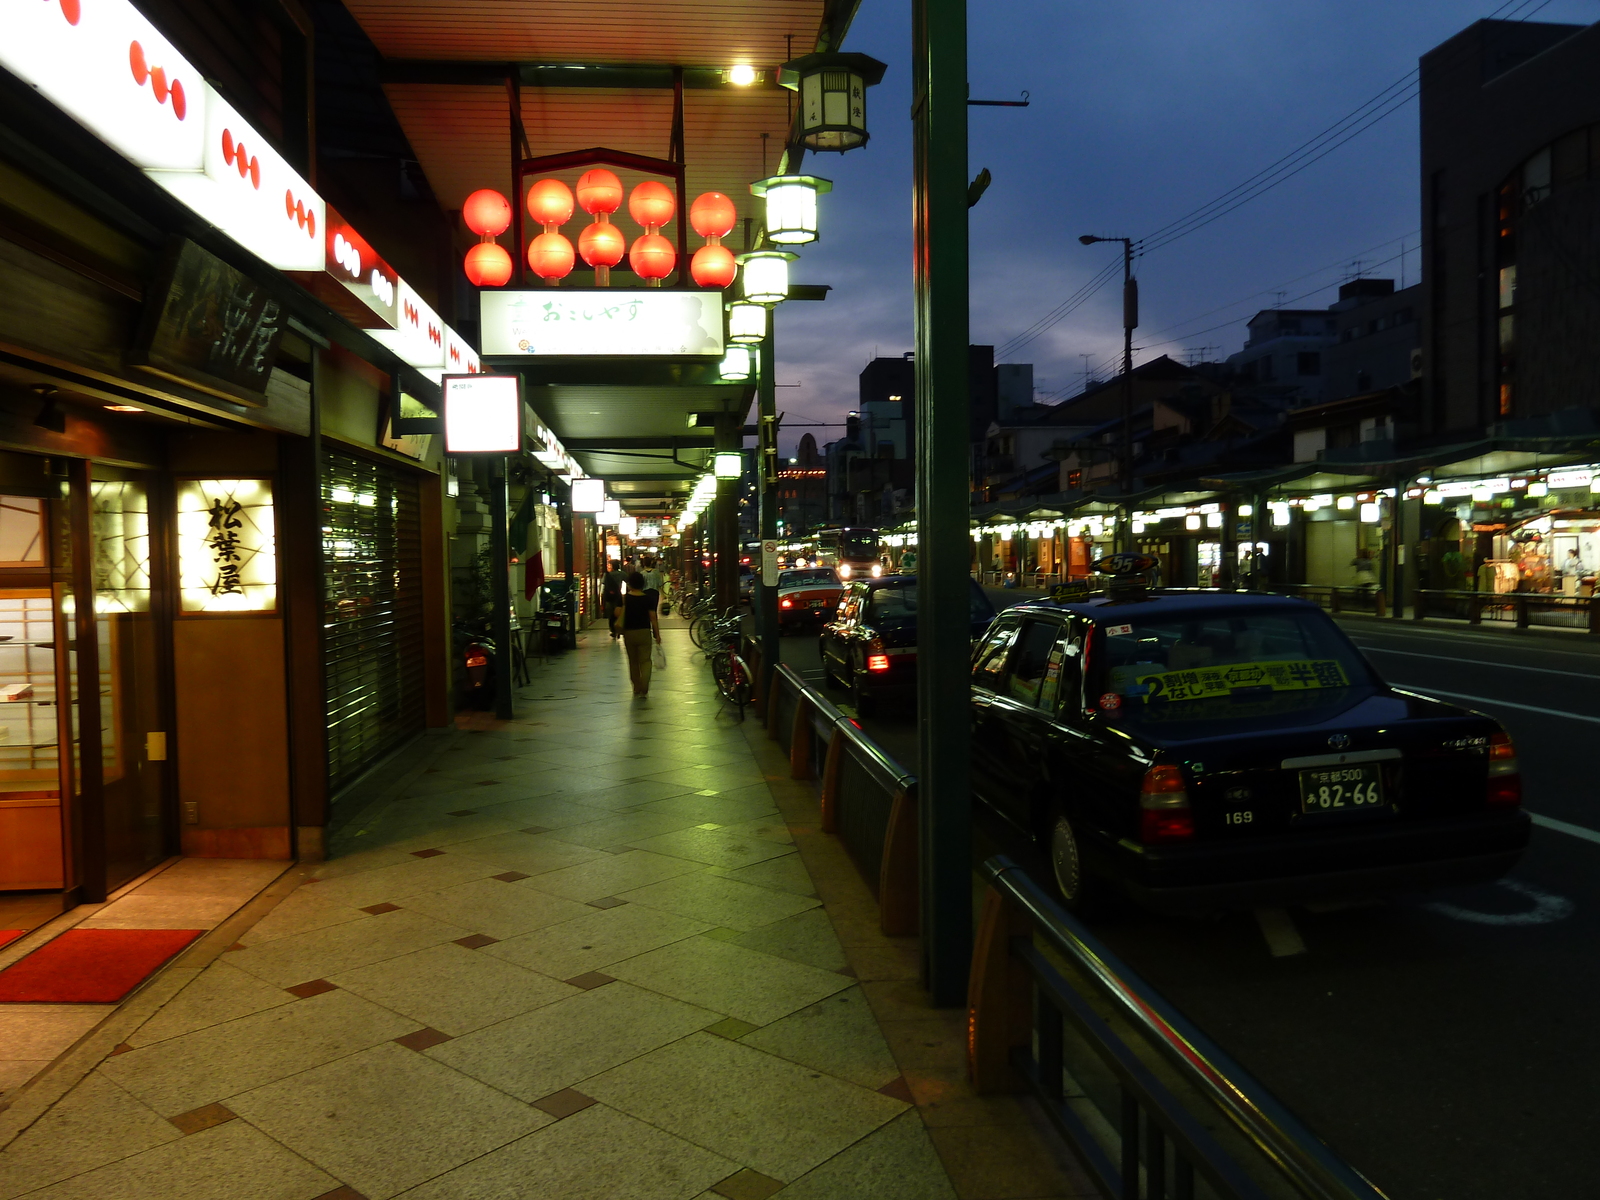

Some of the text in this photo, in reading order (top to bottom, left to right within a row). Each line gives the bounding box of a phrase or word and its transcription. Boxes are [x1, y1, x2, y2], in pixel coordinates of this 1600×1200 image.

[542, 298, 645, 322] おこしやす
[208, 497, 243, 595] 松葉屋
[1112, 556, 1133, 573] 55
[1108, 625, 1130, 635] 小型
[1318, 768, 1363, 784] 京都500
[1306, 781, 1379, 808] あ 82-66
[1225, 811, 1253, 825] 169
